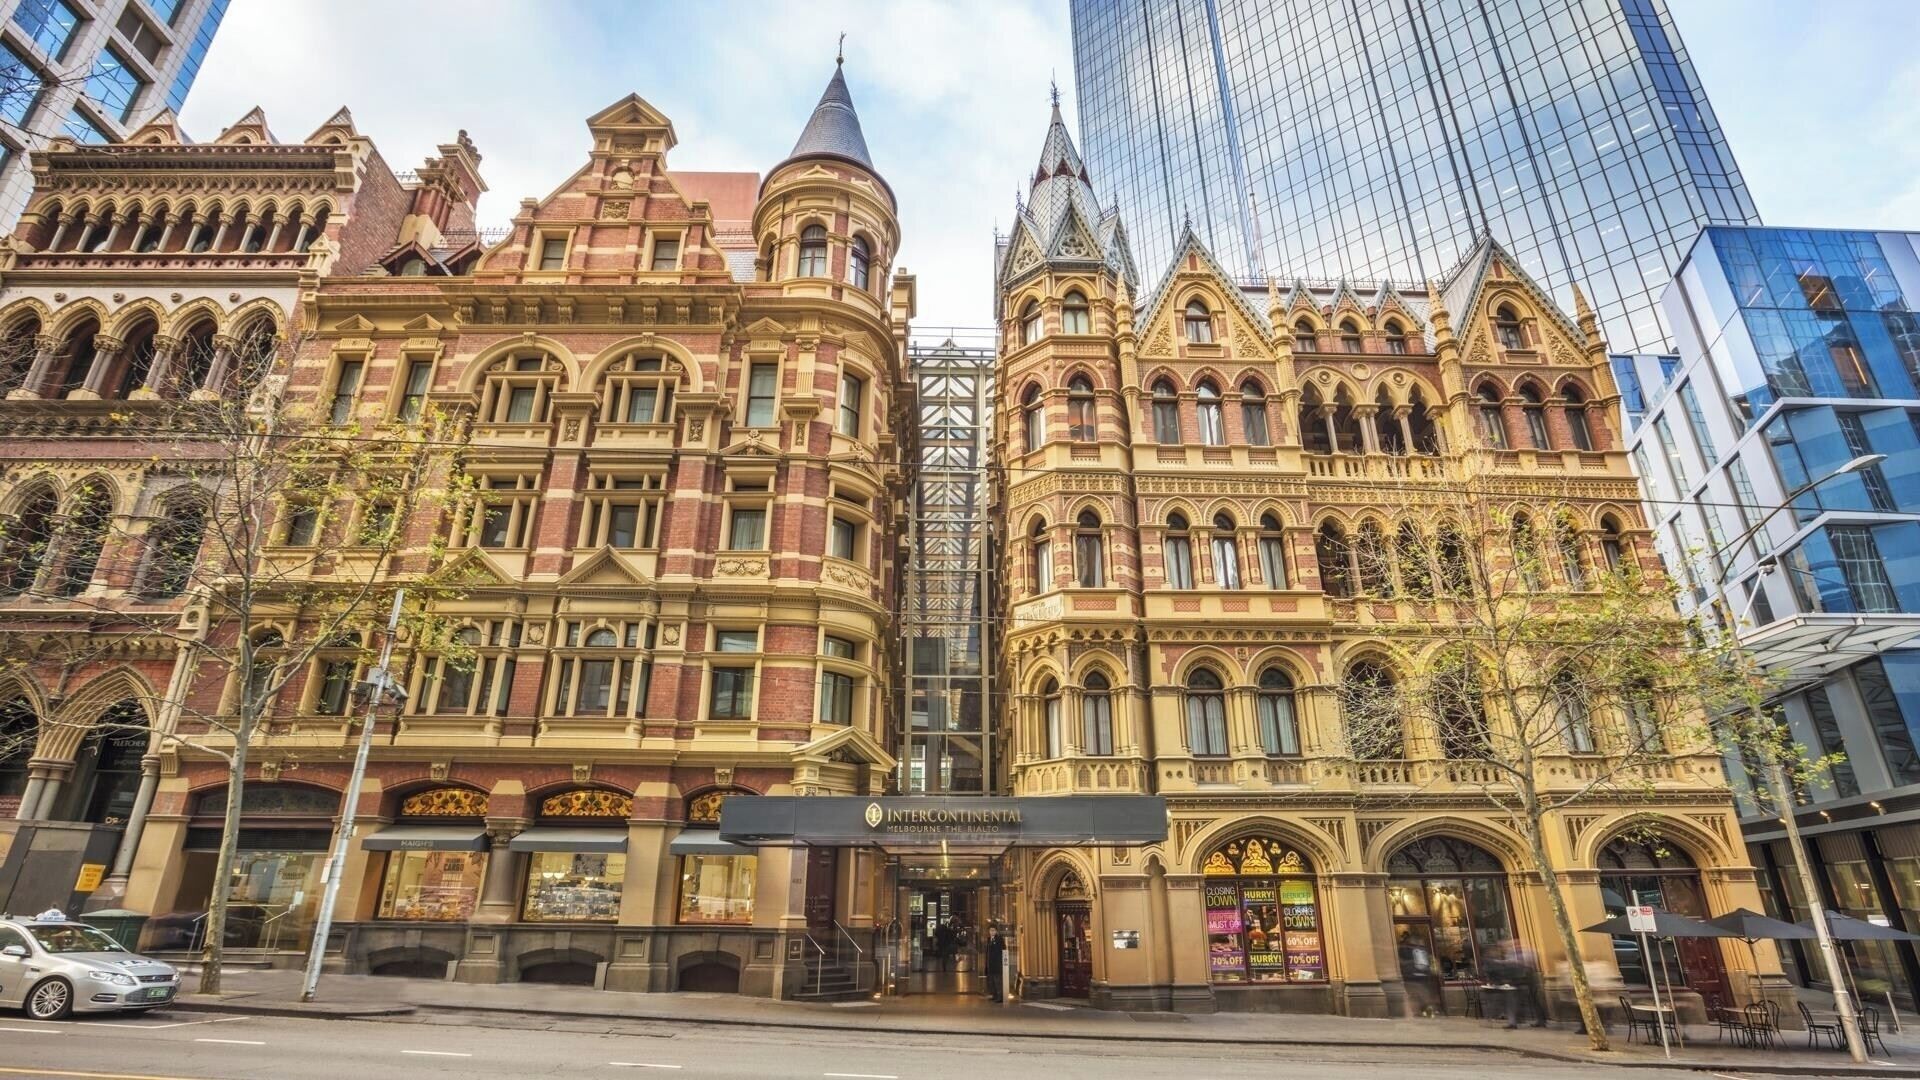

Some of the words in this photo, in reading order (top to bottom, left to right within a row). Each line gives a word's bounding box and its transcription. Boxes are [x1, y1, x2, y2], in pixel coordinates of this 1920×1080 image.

[887, 808, 1023, 823] INTERCONTINENTAL
[887, 825, 941, 833] MELBOURNE
[945, 825, 963, 833] THE
[967, 825, 999, 833] RIALTO
[1206, 887, 1235, 895] CLOSING
[1244, 890, 1274, 898] HURRY!
[1207, 896, 1236, 906] DOWN
[1284, 907, 1313, 916] CLOSING
[1209, 920, 1228, 929] MUST
[1229, 920, 1240, 929] GO
[1285, 917, 1314, 927] DOWN
[1303, 937, 1318, 946] OFF
[1212, 957, 1229, 965] 70%
[1229, 956, 1243, 965] OFF
[1250, 954, 1282, 963] HURRY!
[1288, 955, 1306, 964] 70%
[1305, 955, 1320, 964] OFF
